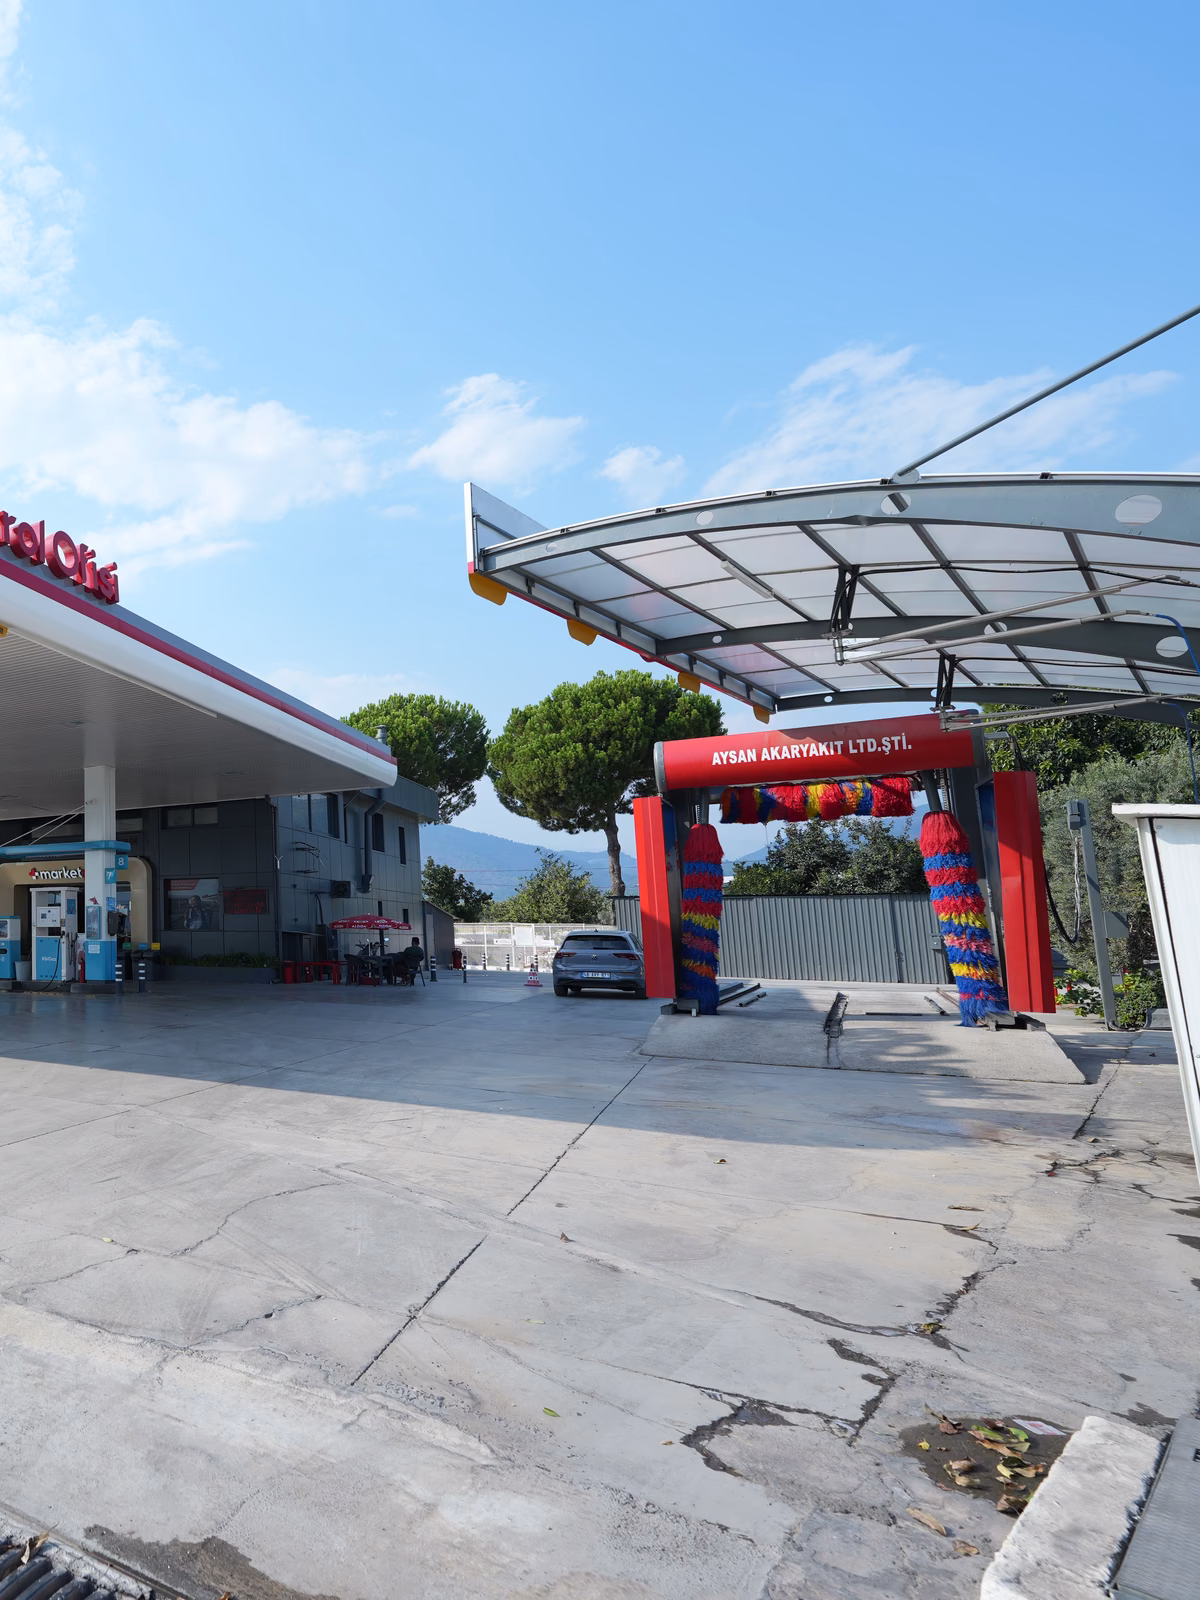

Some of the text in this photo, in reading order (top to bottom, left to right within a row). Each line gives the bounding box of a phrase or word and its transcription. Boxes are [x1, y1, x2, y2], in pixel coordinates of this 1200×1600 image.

[46, 530, 120, 605] Ofisi
[712, 733, 912, 765] AYSAN AKARYAKIT LTD.ŞTİ.
[118, 857, 125, 865] 8
[40, 867, 82, 880] market
